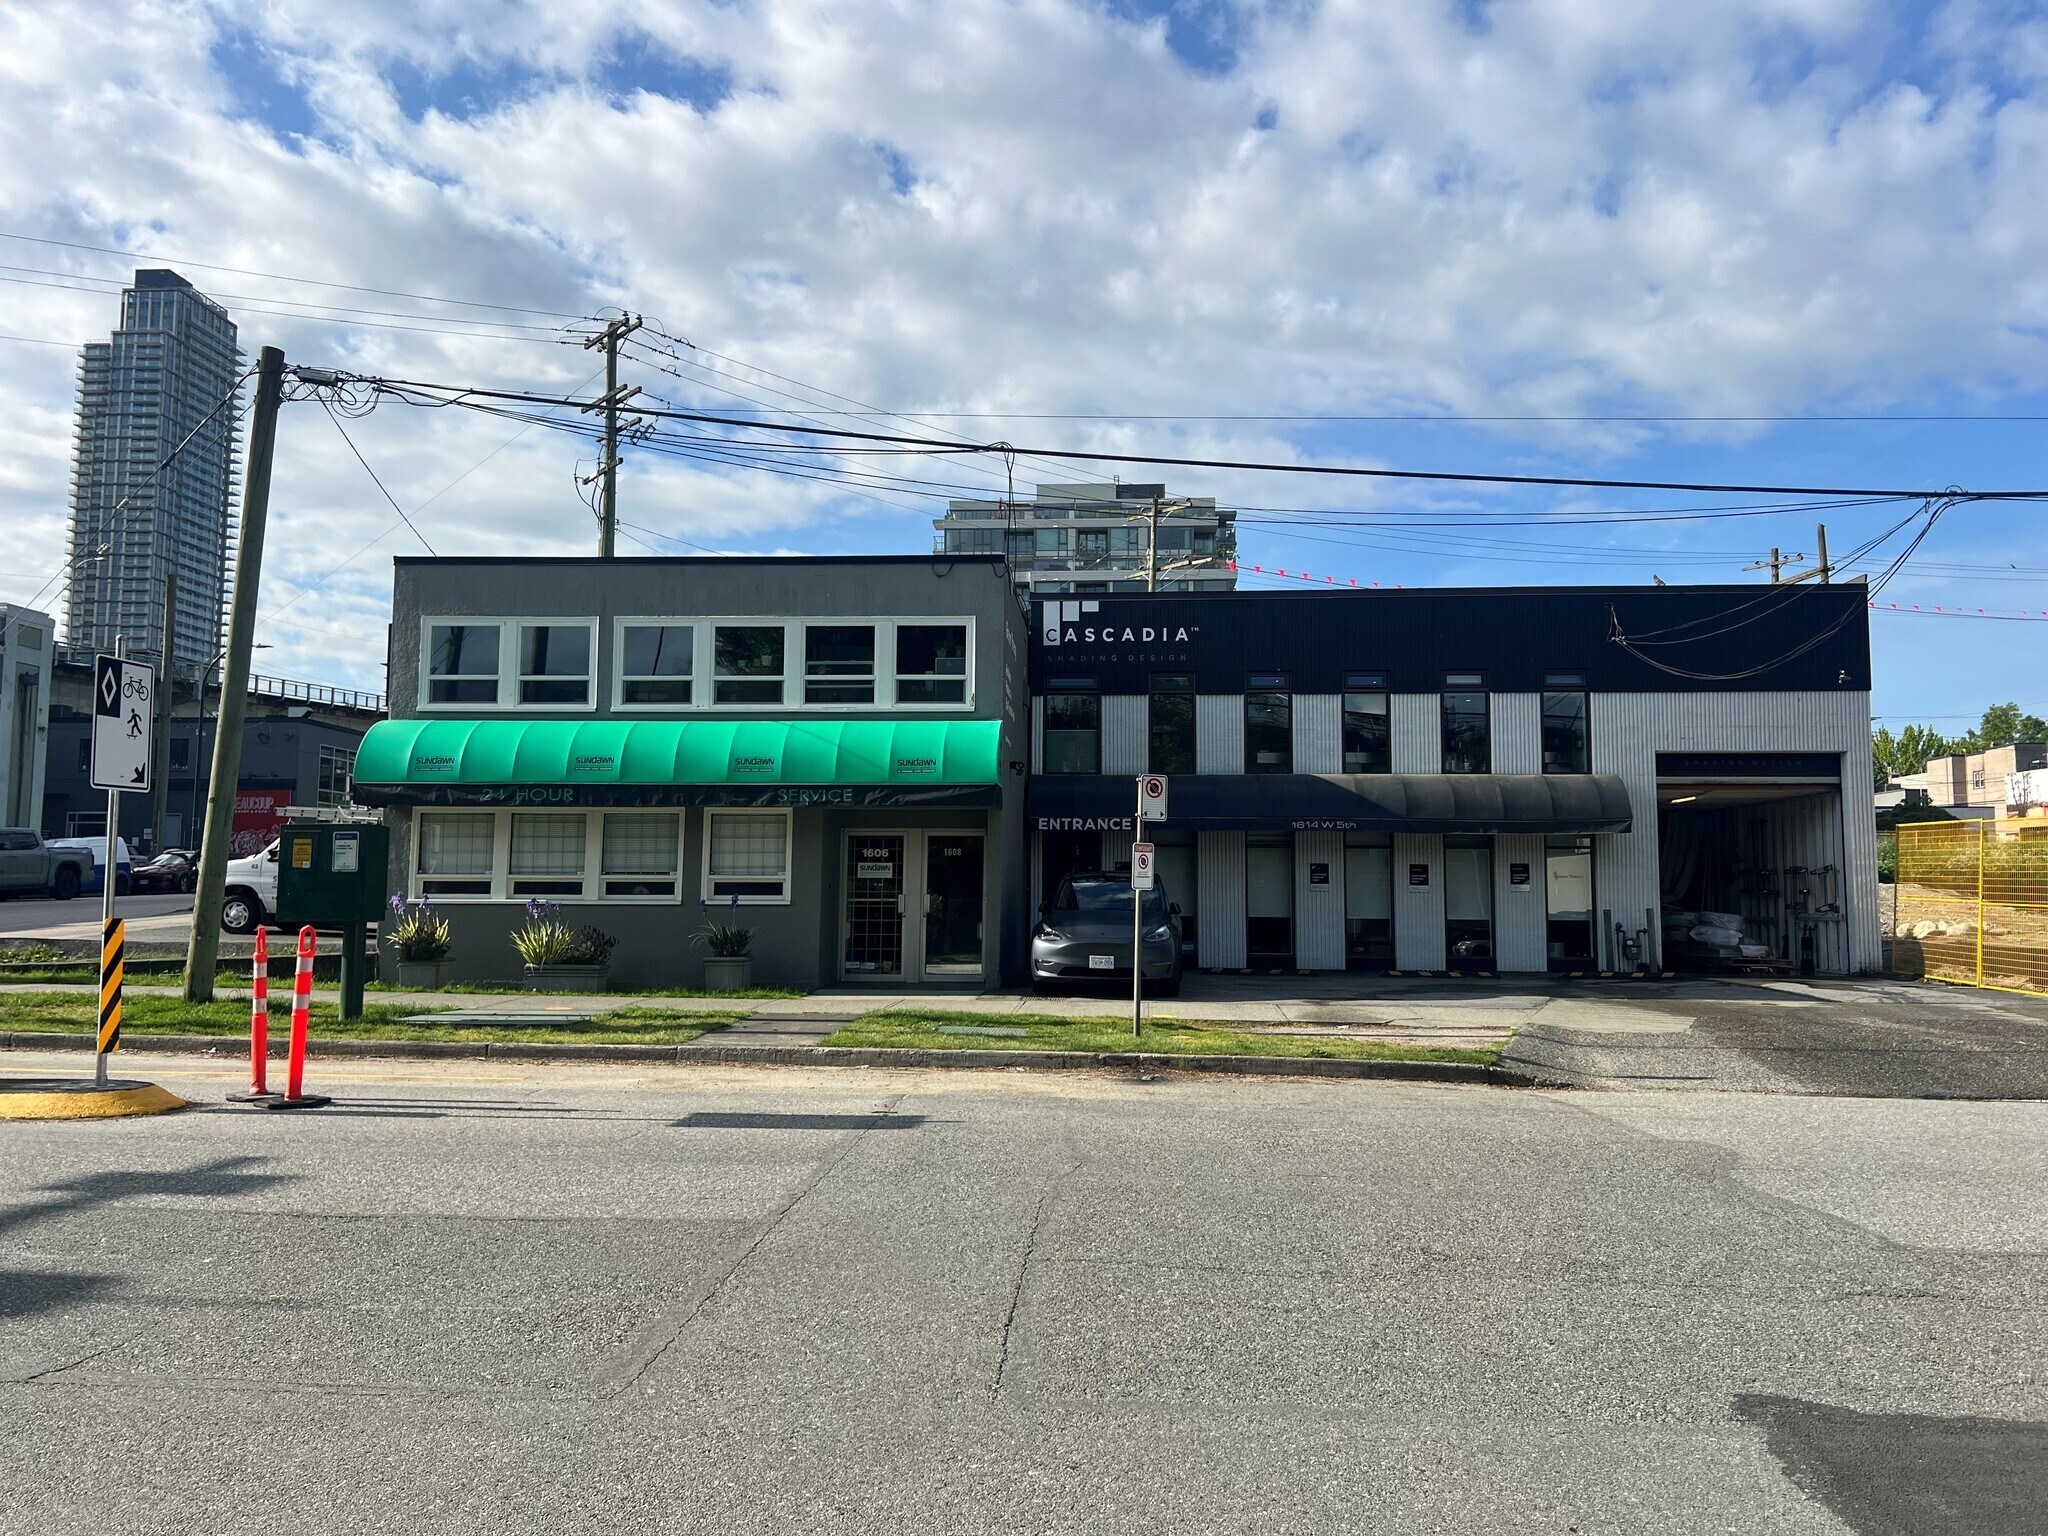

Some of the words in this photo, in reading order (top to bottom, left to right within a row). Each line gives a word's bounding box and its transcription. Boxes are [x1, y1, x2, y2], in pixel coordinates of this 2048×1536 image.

[1045, 627, 1189, 643] CASCADIA
[1047, 654, 1118, 662] SHADING
[1128, 654, 1187, 662] DESIGN
[480, 788, 505, 801] 24
[515, 788, 574, 801] HOUR
[777, 788, 853, 801] SERVICE
[235, 797, 274, 809] EAUCOUP
[1038, 817, 1132, 830] ENTRANCE
[1291, 821, 1319, 829] 1614
[1321, 821, 1335, 829] W
[1336, 821, 1357, 829] 5th
[862, 848, 889, 857] 1606
[944, 848, 962, 856] 1608
